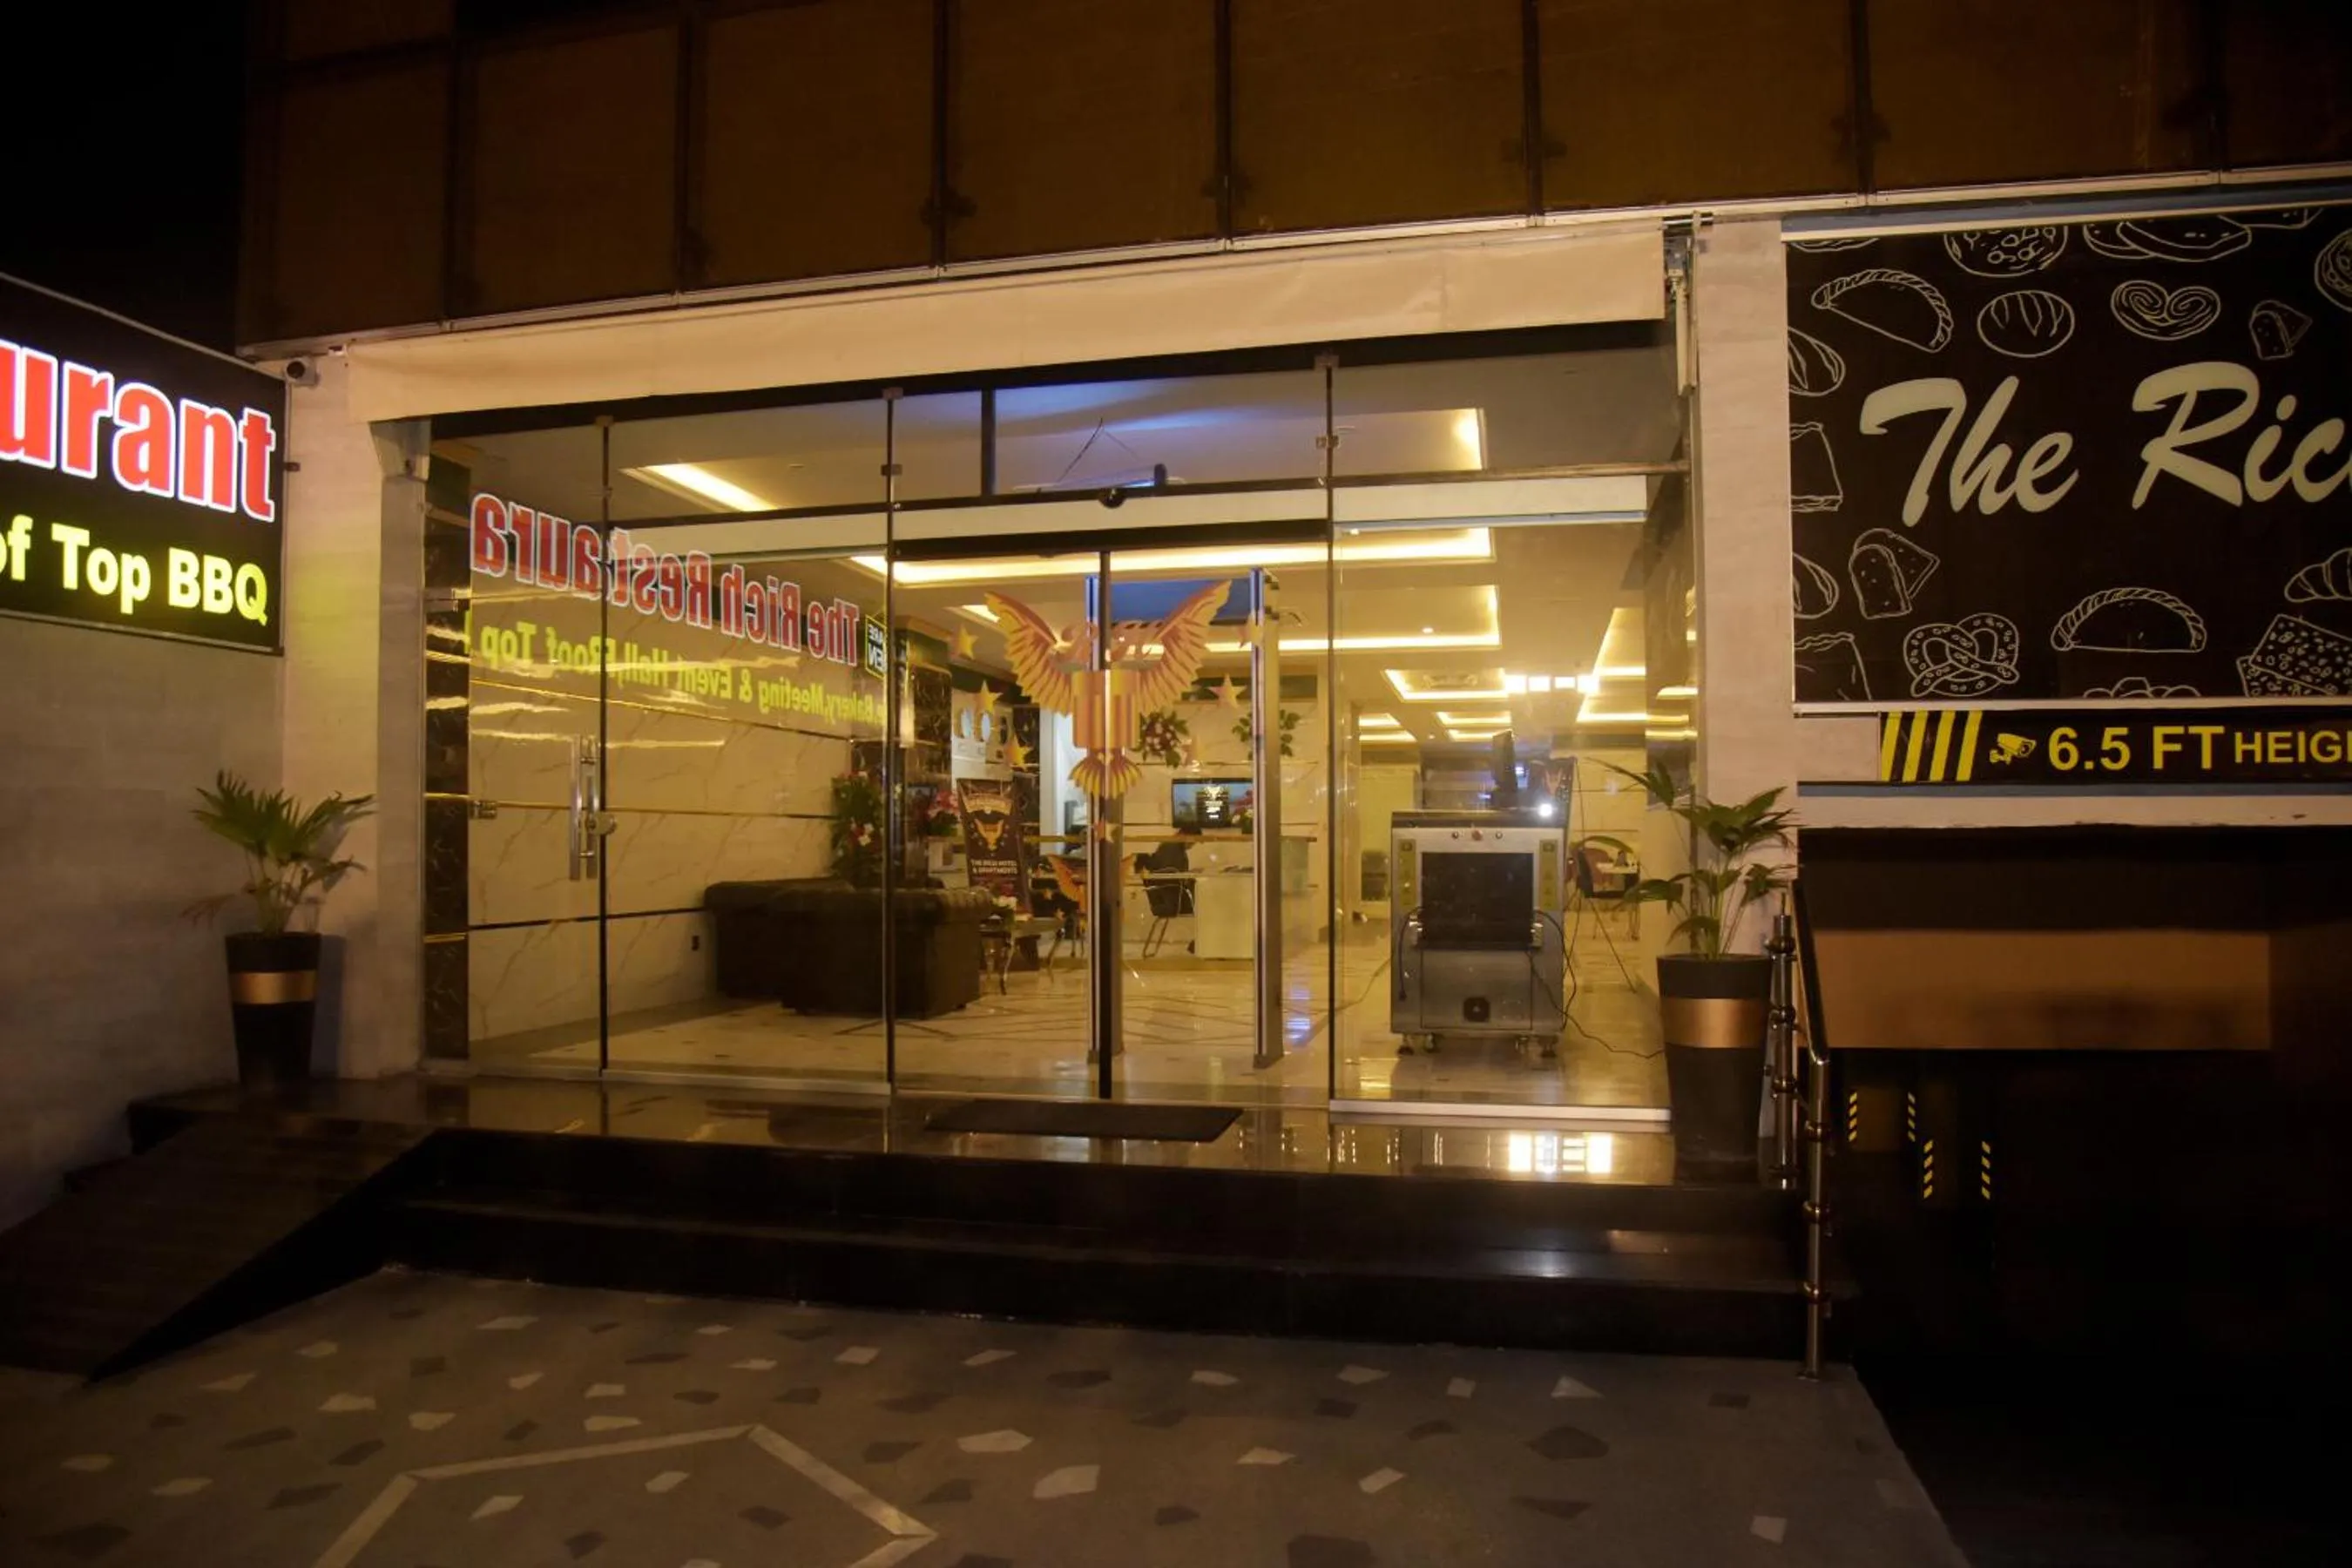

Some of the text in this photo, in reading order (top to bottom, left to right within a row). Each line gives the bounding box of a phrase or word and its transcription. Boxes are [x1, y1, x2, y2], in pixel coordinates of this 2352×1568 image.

[0, 340, 275, 523] urant
[1860, 361, 2352, 527] The Ric
[0, 514, 267, 626] f Top BBQ
[2048, 727, 2131, 770] 6.5
[2153, 726, 2225, 770] FT
